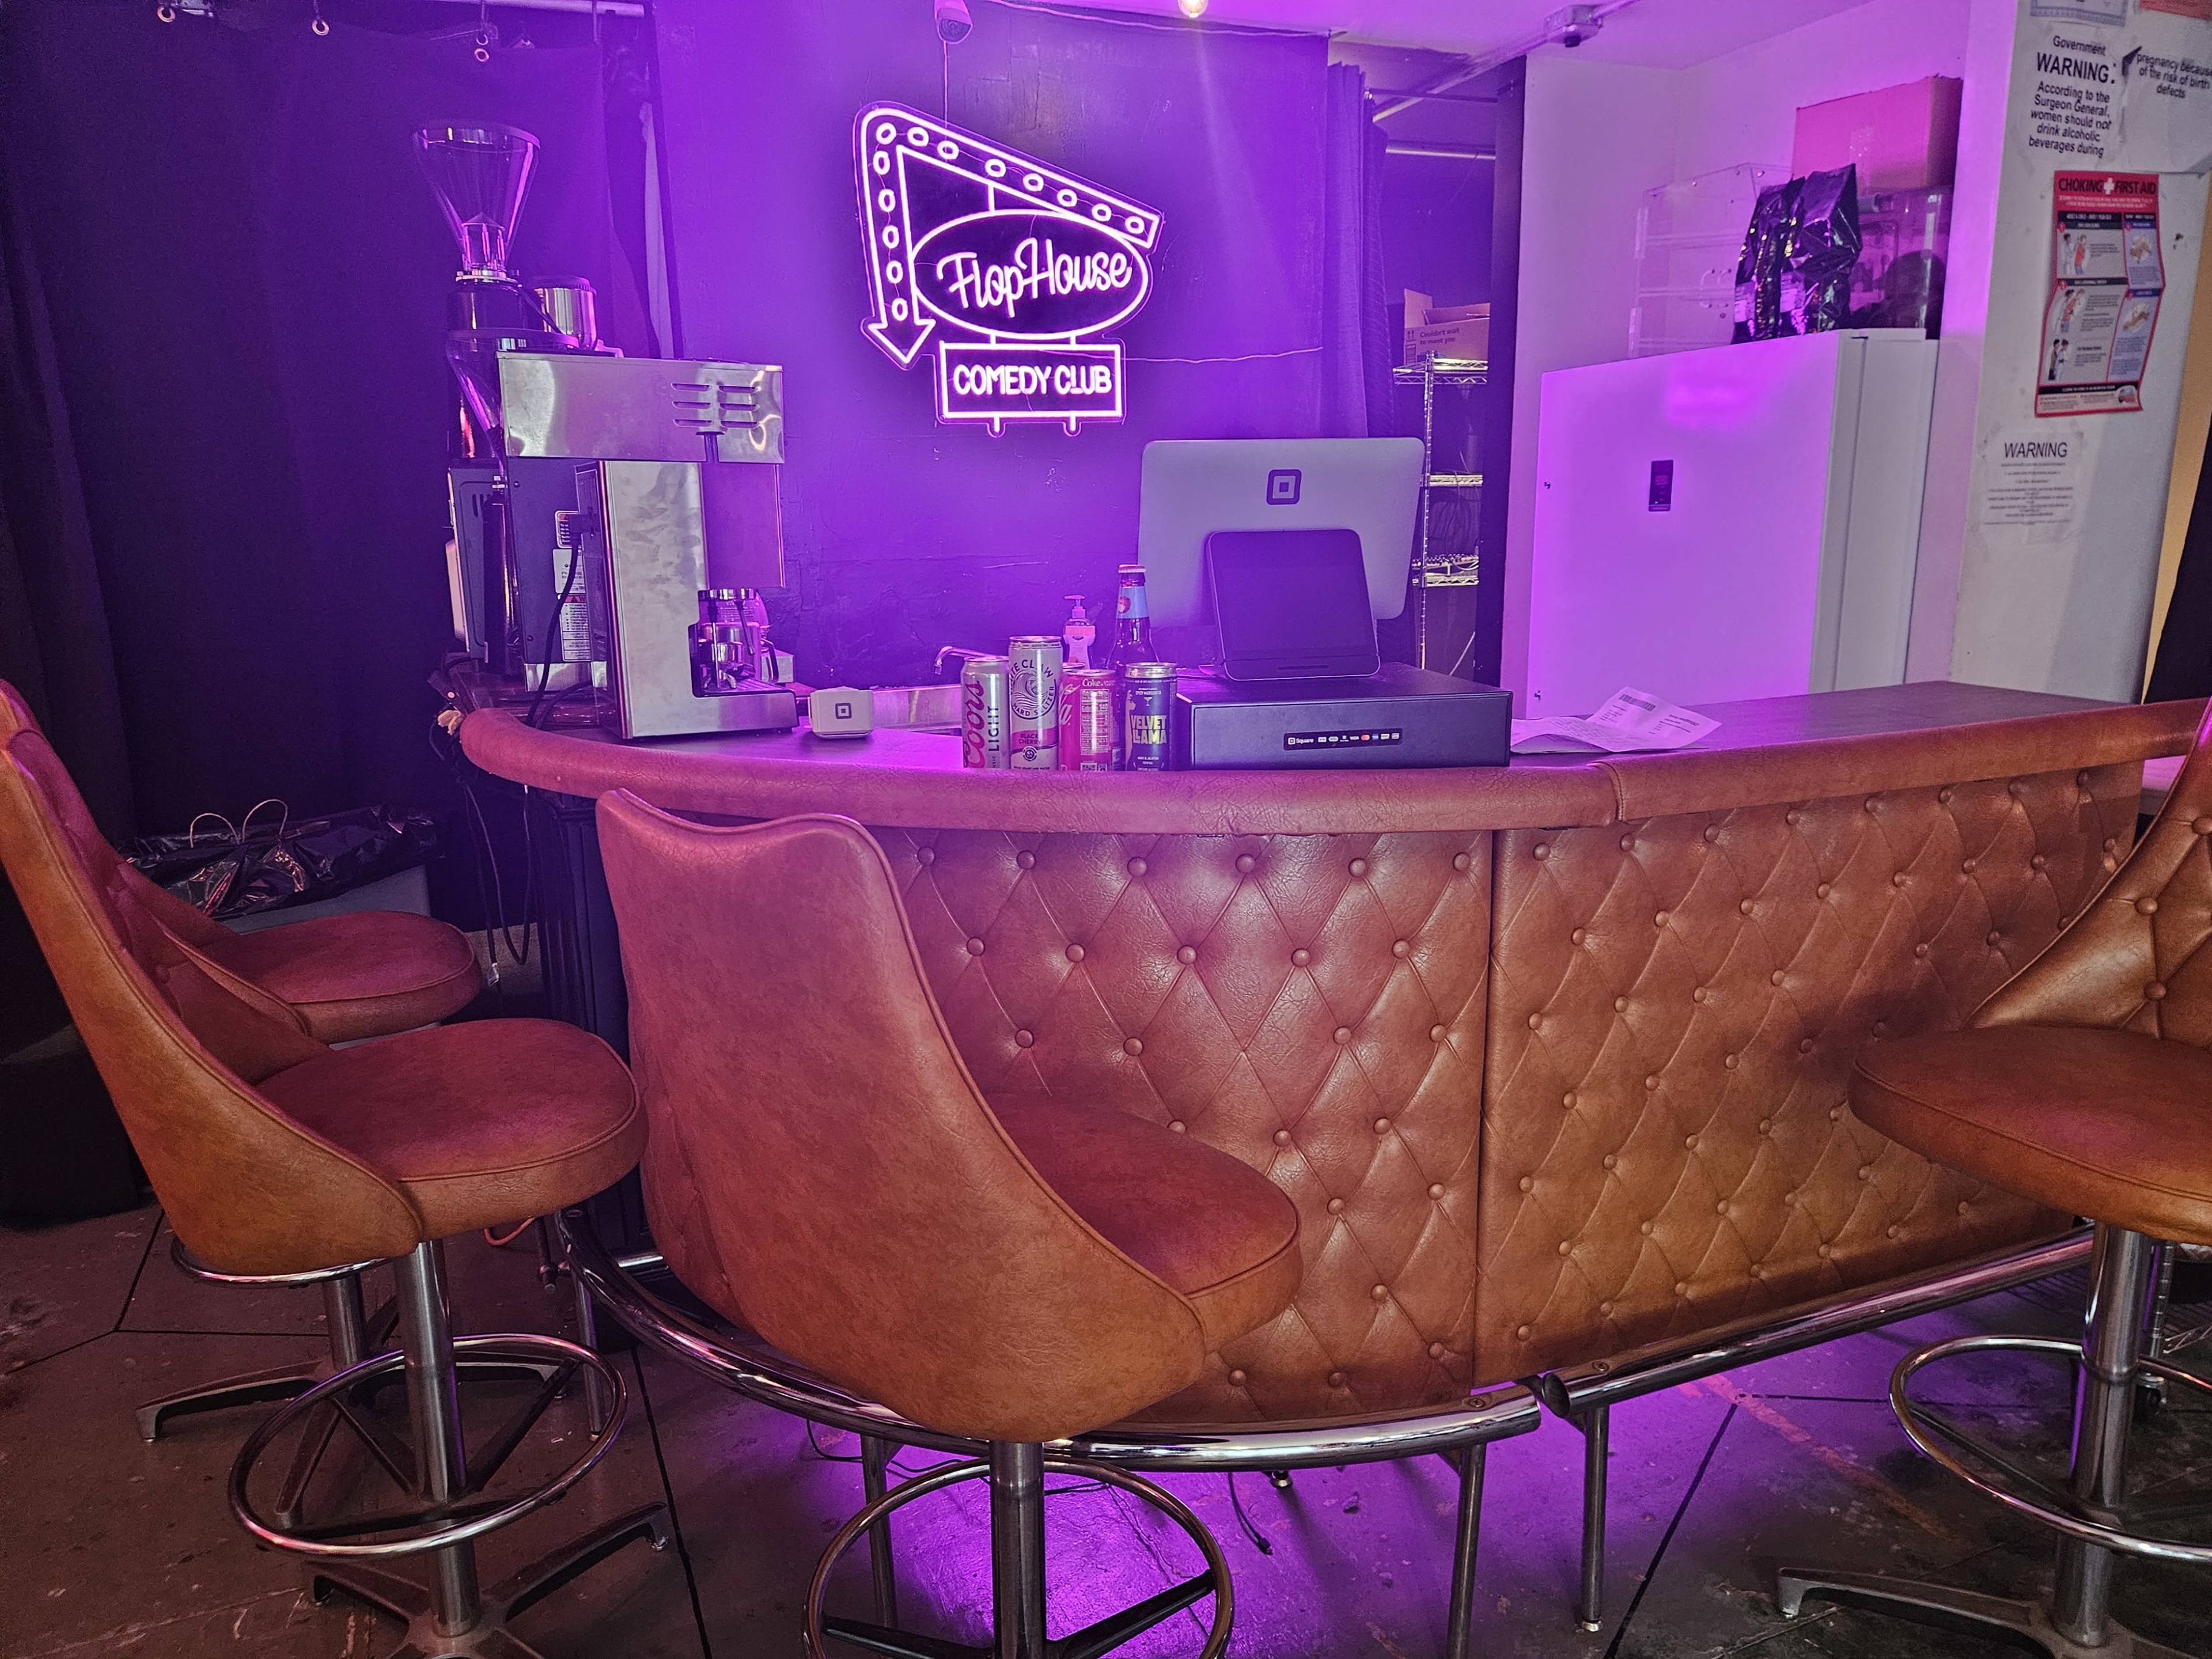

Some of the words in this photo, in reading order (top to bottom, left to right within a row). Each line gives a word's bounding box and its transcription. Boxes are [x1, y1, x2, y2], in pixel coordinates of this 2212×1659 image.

[2053, 36, 2105, 56] Government
[2137, 54, 2179, 74] pregnancy
[2139, 66, 2148, 76] of
[2149, 69, 2161, 80] the
[2037, 81, 2082, 103] According
[2085, 89, 2093, 101] to
[2096, 90, 2110, 103] the
[2157, 83, 2186, 99] defects
[2035, 94, 2072, 111] Surgeon
[2031, 110, 2062, 123] women
[2065, 113, 2094, 128] should
[2096, 119, 2112, 131] not
[2037, 122, 2060, 137] drink
[2062, 126, 2101, 142] alcoholic
[2029, 135, 2075, 154] beverages
[2077, 142, 2104, 159] during
[2058, 178, 2103, 193] CHOKING
[2115, 180, 2138, 194] FIRST
[2139, 181, 2157, 195] AID
[953, 364, 1052, 396] COMEDY
[1054, 364, 1112, 395] CLUB
[2004, 441, 2068, 459] WARNING
[1082, 678, 1100, 687] Coke
[1013, 703, 1031, 717] HARD
[1033, 685, 1055, 715] SLTZER
[963, 680, 985, 768] Coors
[987, 706, 999, 752] LIGHT
[1130, 715, 1167, 730] VELVET
[1132, 729, 1167, 745] LLAMA
